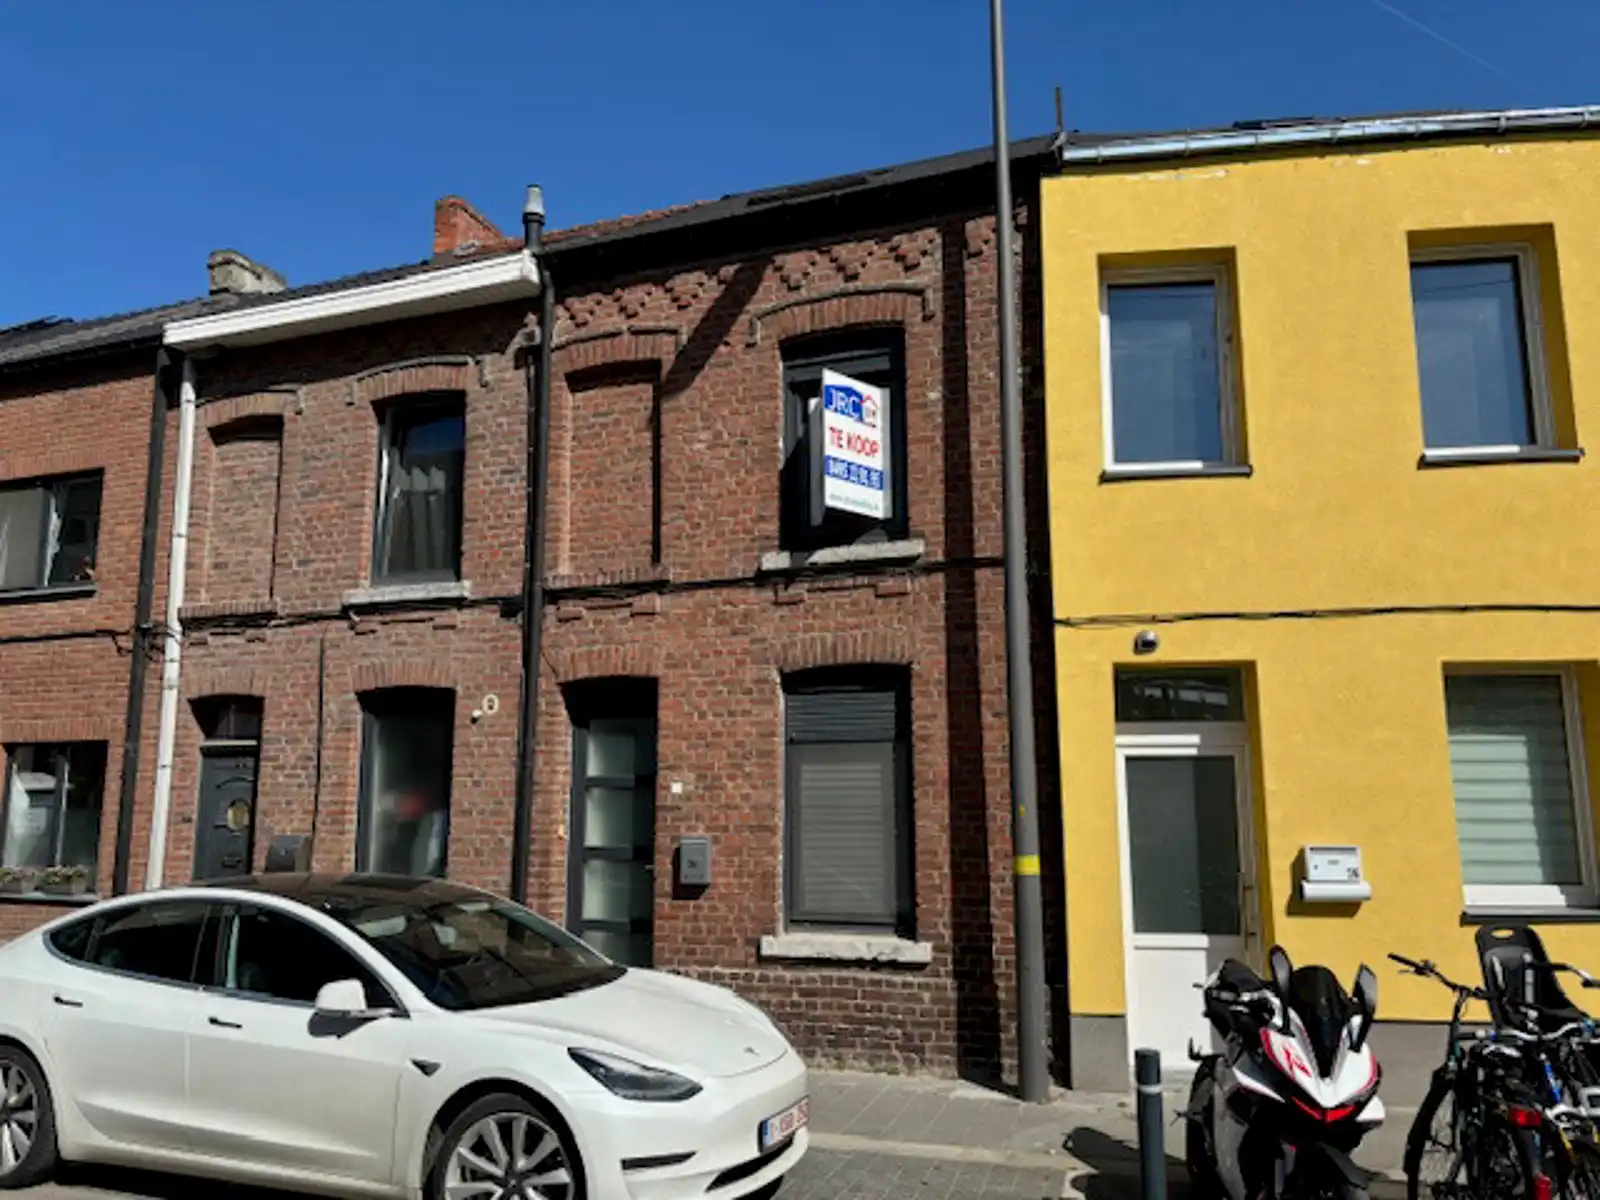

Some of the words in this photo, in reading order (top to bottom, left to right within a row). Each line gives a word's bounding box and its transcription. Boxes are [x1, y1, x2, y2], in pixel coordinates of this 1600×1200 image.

[827, 387, 861, 422] JRC
[828, 426, 844, 450] TE
[846, 432, 880, 458] KOOP
